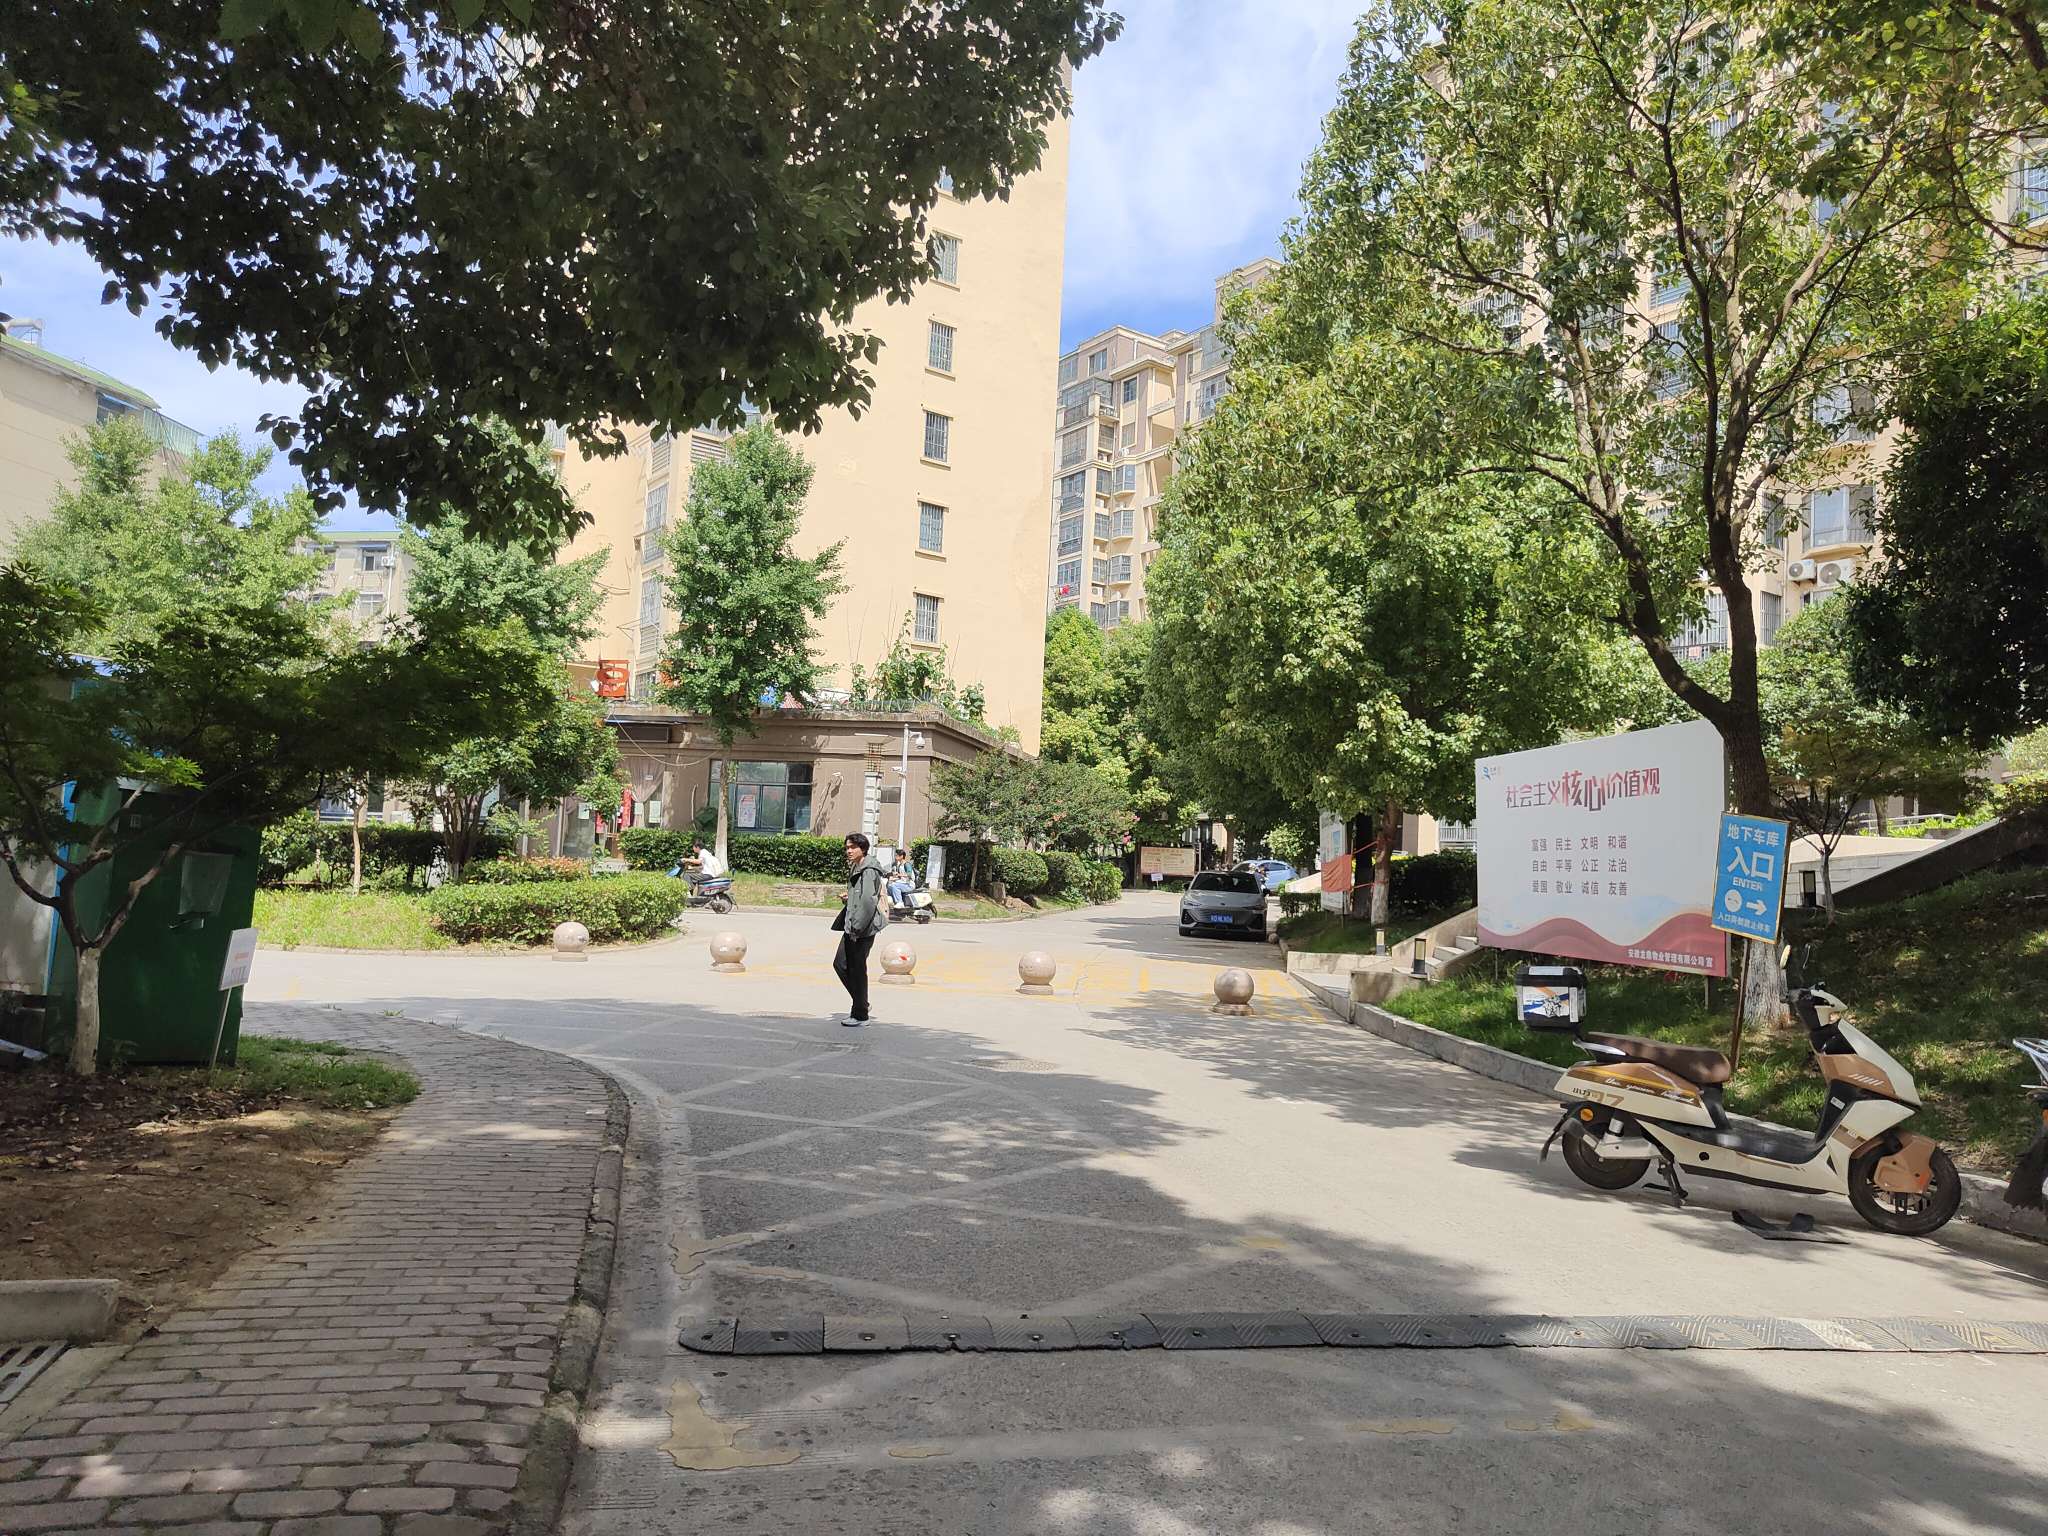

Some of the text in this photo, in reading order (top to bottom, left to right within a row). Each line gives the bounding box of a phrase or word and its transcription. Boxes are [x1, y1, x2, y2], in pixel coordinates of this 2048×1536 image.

[1505, 767, 1661, 812] 社会主义核心价值观
[1531, 834, 1628, 852] 富强 民主 文明 和谐
[1727, 823, 1780, 848] 地下车库
[1532, 857, 1628, 873] 自由 平等 公正 法治
[1727, 846, 1775, 881] 入口
[1532, 880, 1628, 897] 爱国 敬业 诚信 友善
[1732, 876, 1763, 892] ENTER
